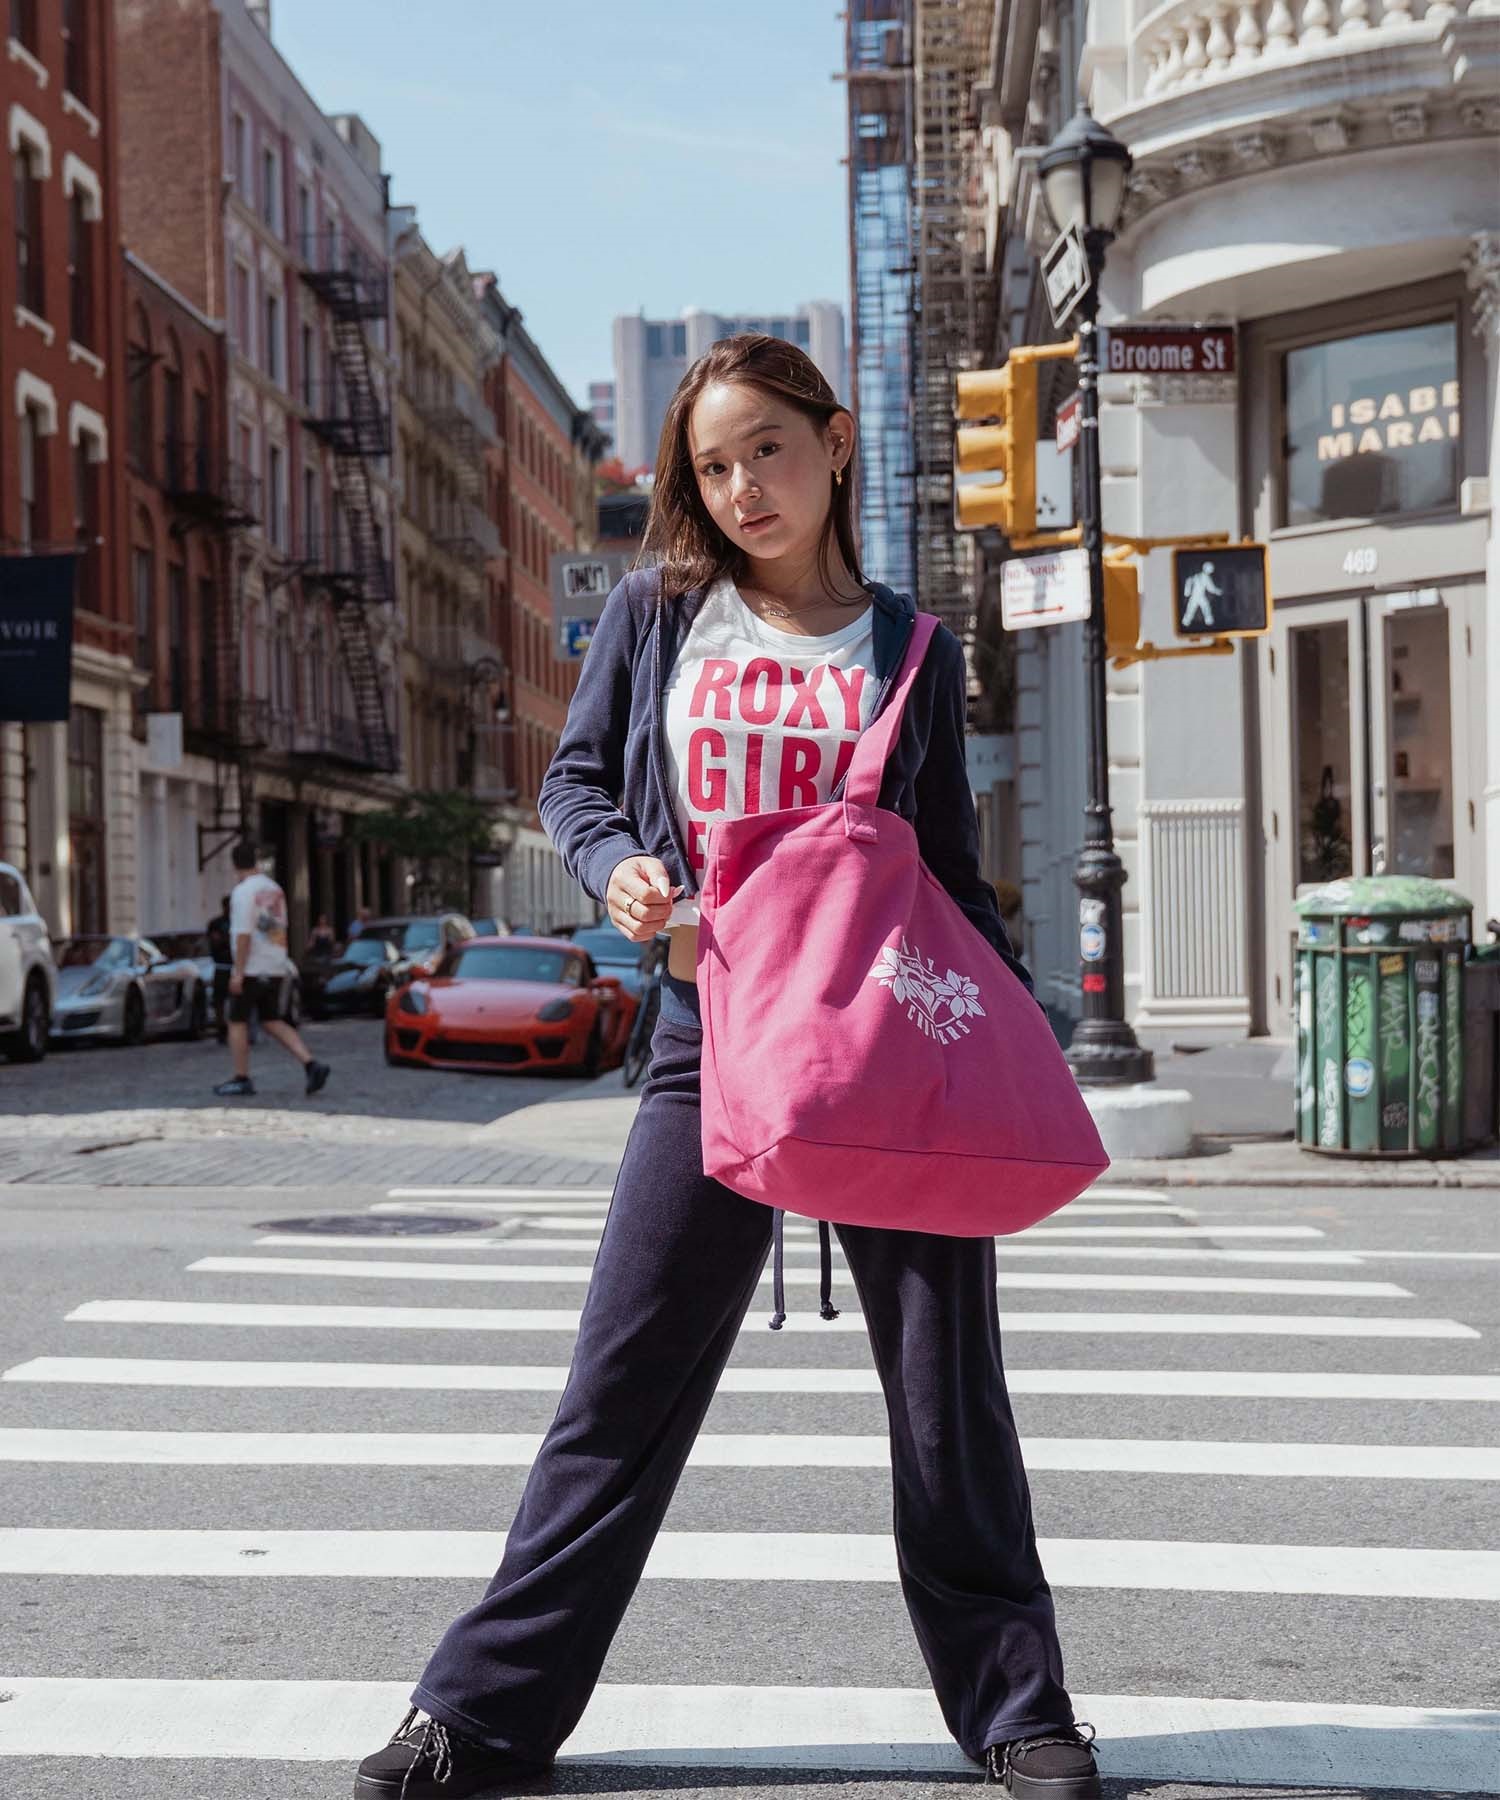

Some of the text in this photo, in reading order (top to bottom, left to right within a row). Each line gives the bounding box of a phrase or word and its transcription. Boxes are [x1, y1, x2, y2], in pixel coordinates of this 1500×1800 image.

[1110, 337, 1225, 370] Broome St
[688, 657, 866, 731] ROXY
